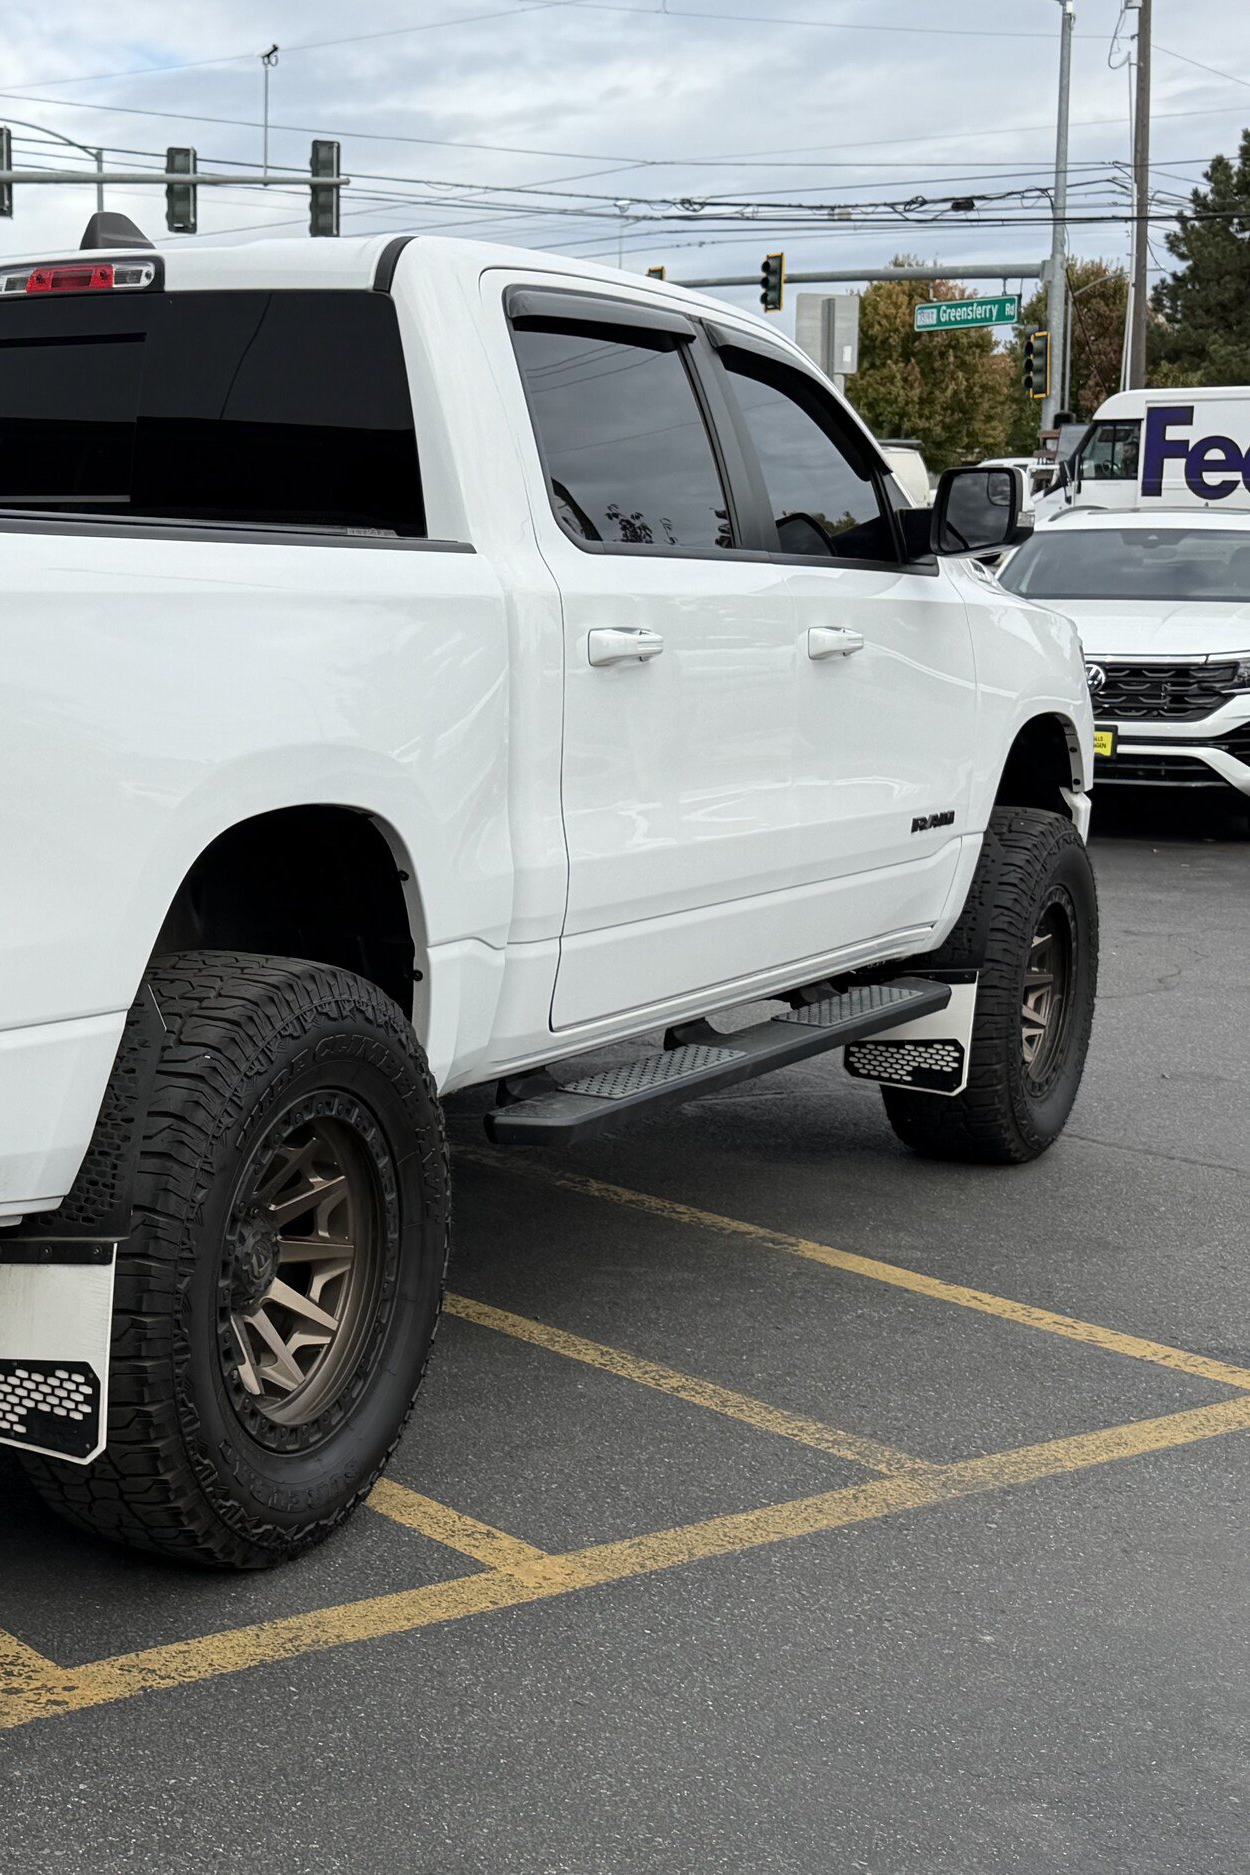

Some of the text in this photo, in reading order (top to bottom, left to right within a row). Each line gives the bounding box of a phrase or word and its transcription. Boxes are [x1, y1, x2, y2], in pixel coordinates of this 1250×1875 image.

[940, 303, 998, 322] Greensferry
[1005, 303, 1015, 316] Rd
[1141, 406, 1250, 500] Fe
[911, 810, 955, 833] RAM
